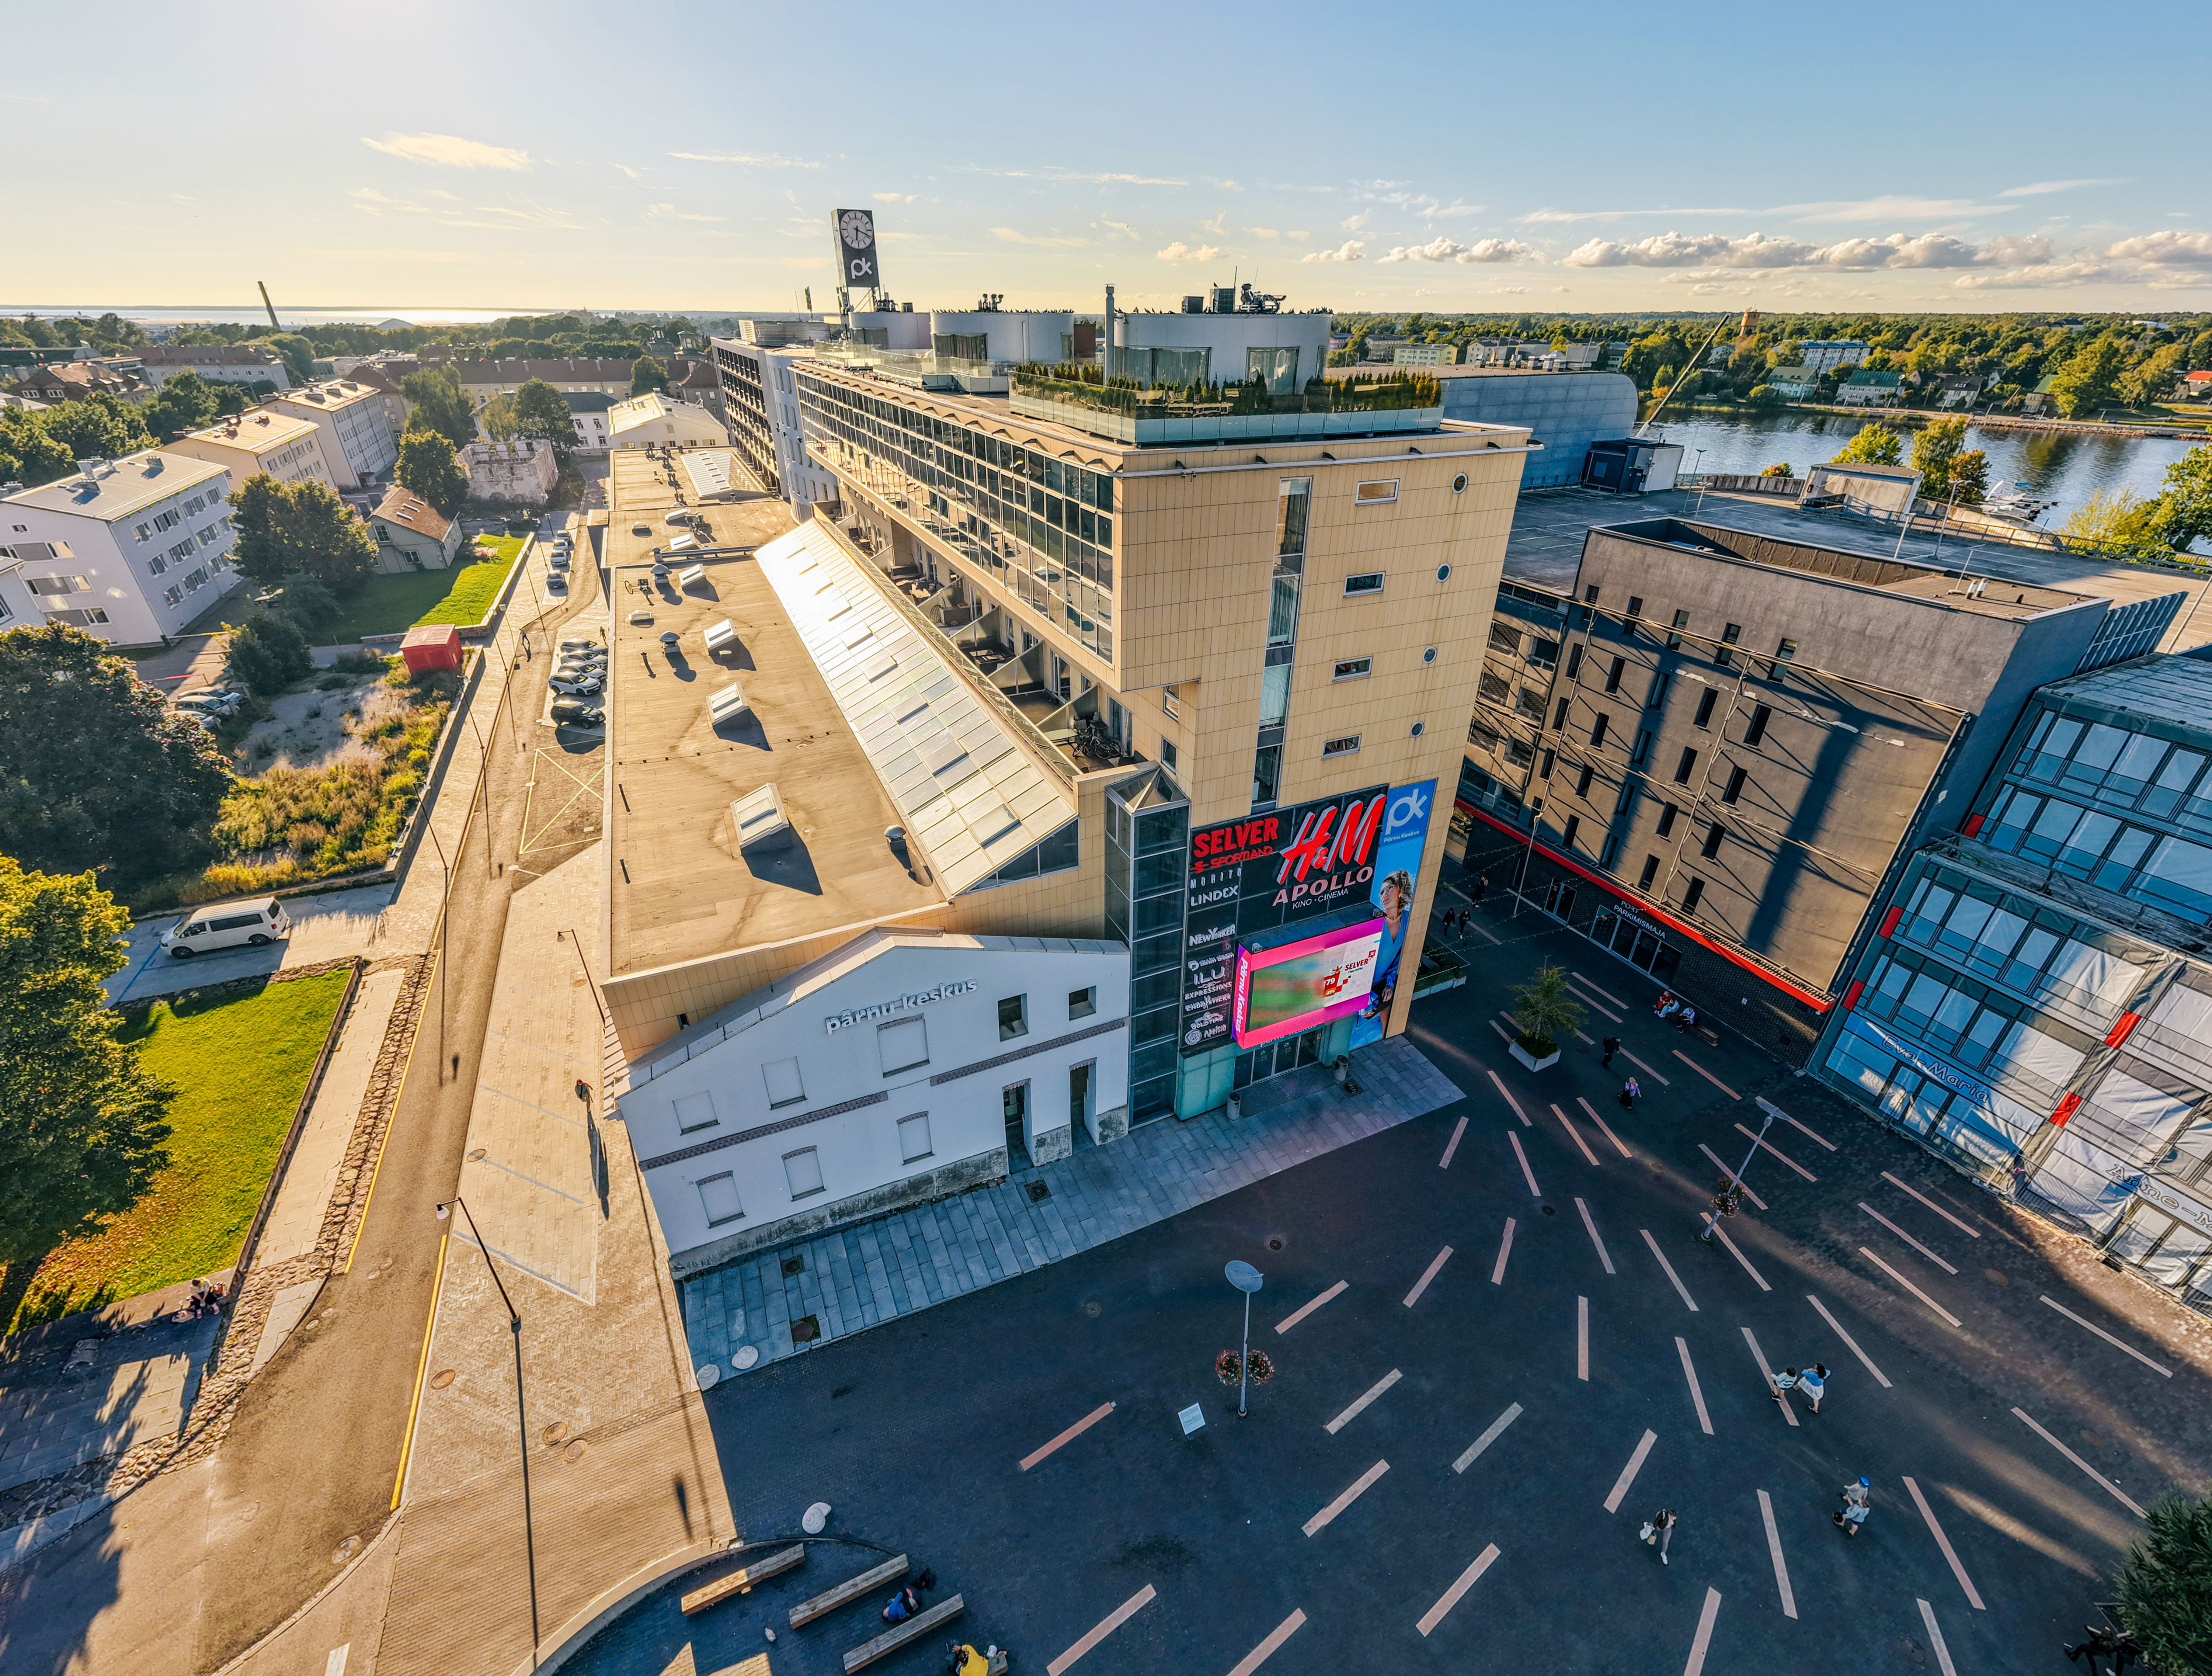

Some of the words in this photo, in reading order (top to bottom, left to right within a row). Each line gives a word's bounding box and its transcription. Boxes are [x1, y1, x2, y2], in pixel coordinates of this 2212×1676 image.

[1193, 817, 1279, 858] SELVER
[1276, 793, 1387, 885] H&M
[1401, 830, 1420, 839] Keskus
[1210, 846, 1273, 869] SPORTLAND
[1190, 867, 1242, 889] MOHITO
[1272, 866, 1373, 906] APOLLO
[1190, 885, 1239, 907] LINDEX
[1292, 898, 1312, 909] KINO
[1318, 888, 1349, 902] CINEMA
[1621, 900, 1639, 914] PORT
[1613, 904, 1666, 939] PARKIMISMAJA
[1199, 957, 1217, 967] denim
[1216, 952, 1235, 962] dream
[1345, 958, 1368, 971] SELVER
[1238, 957, 1248, 994] Pärnu
[1185, 981, 1232, 1000] EXPRESSIONS
[825, 1001, 895, 1036] pärnu
[901, 978, 978, 1011] keskus
[1235, 995, 1245, 1033] Keskus
[1203, 1024, 1227, 1038] Apelsin
